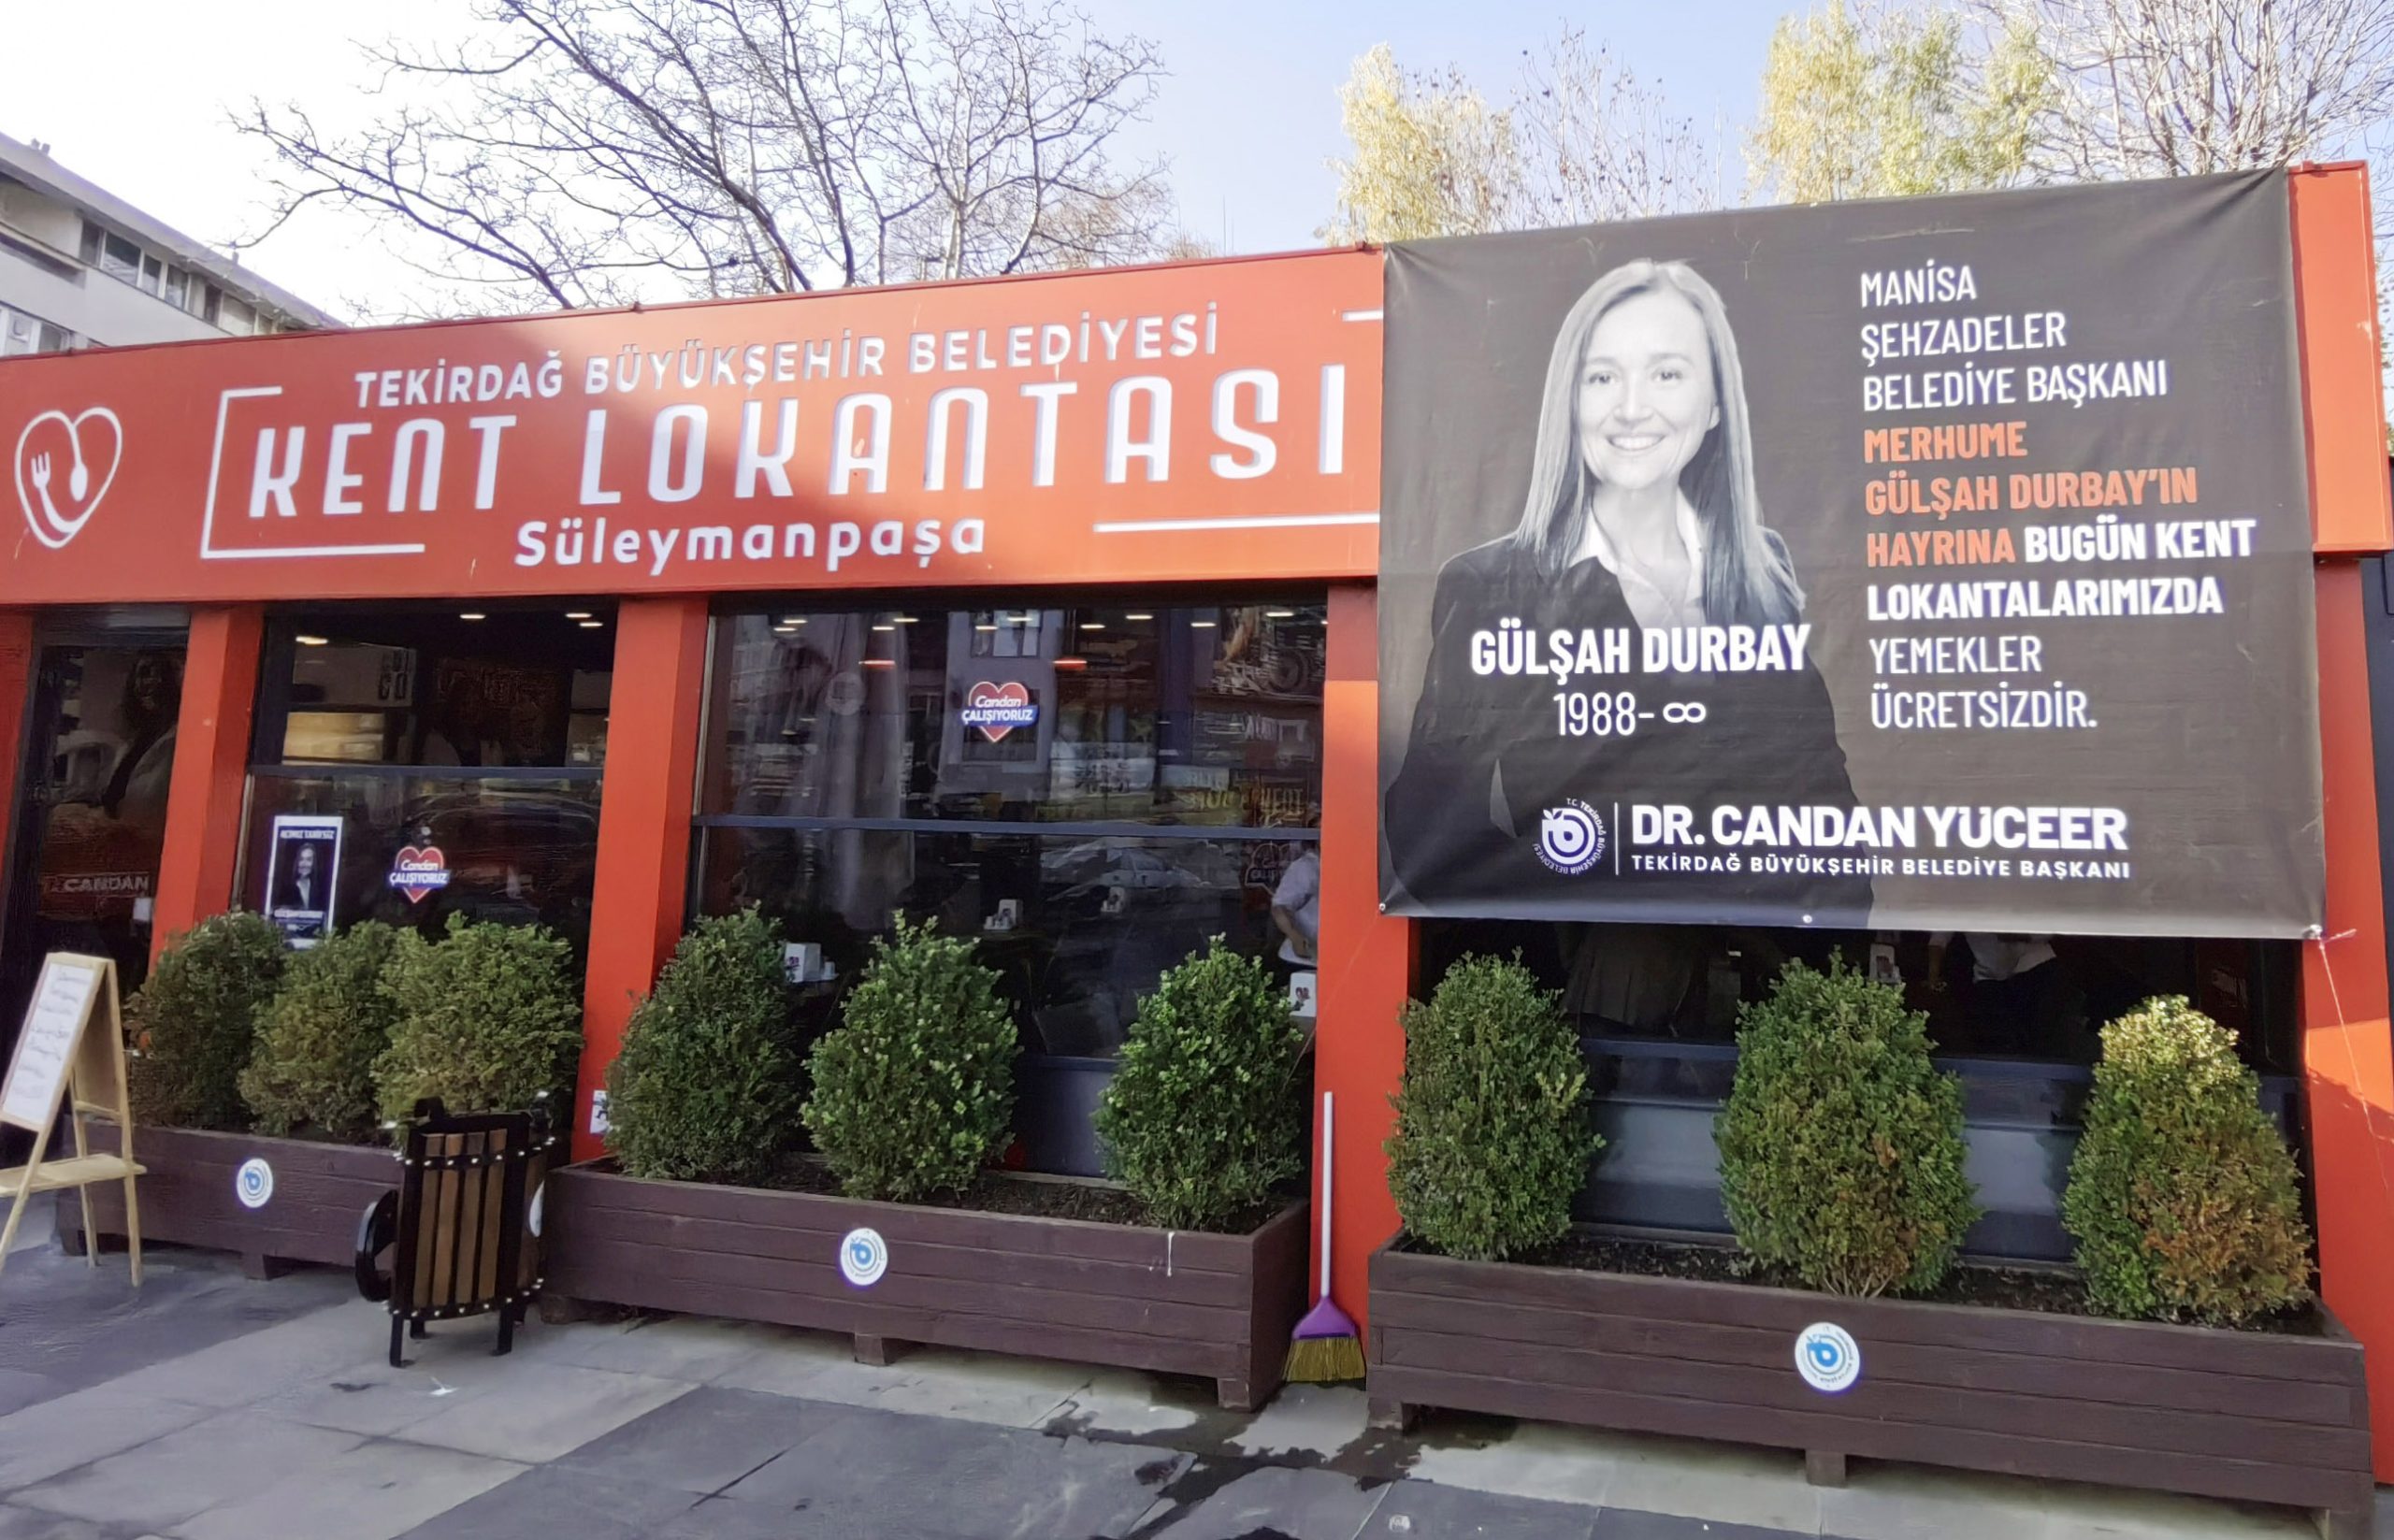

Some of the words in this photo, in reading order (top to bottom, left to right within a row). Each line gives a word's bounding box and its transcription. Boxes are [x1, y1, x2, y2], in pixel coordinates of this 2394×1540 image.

[1860, 259, 1977, 308] MANİSA
[355, 351, 563, 408] TEKİRDAĞ
[584, 328, 885, 395] BÜYÜKŞEHİR
[909, 301, 1218, 374] BELEDİYESİ
[1860, 311, 2067, 367] ŞEHZADELER
[1864, 361, 2016, 411] BELEDİYE
[2026, 359, 2168, 409] BAŞKANI
[249, 415, 517, 518] KENT
[580, 364, 1346, 506] LOKANTASI
[1864, 421, 2027, 464] MERHUME
[1866, 470, 1999, 520] GÜLŞAH
[2010, 468, 2198, 509] DURBAY'IN
[515, 516, 986, 576] Süleymanpaşa
[1867, 528, 2015, 568] HAYRINA
[2025, 513, 2146, 563] BUGÜN
[2156, 519, 2257, 559] KENT
[1867, 576, 2224, 621] LOKANTALARIMIZDA
[1471, 617, 1630, 685] GÜLŞAH
[1642, 624, 1811, 673] DURBAY
[1868, 635, 2042, 674] YEMEKLER
[961, 709, 1033, 725] ÇALIŞIYORUZ
[975, 695, 1022, 708] Candan
[1870, 681, 2098, 728] ÜCRETSİZDİR.
[1631, 805, 1705, 845] DR.
[1711, 805, 1916, 848] CANDAN
[1631, 852, 1741, 872] TEKİRDAĞ
[1751, 852, 1894, 877] BÜYÜKŞEHİR
[1902, 856, 2011, 876] BELEDİYE
[2020, 860, 2130, 880] BAŞKANI
